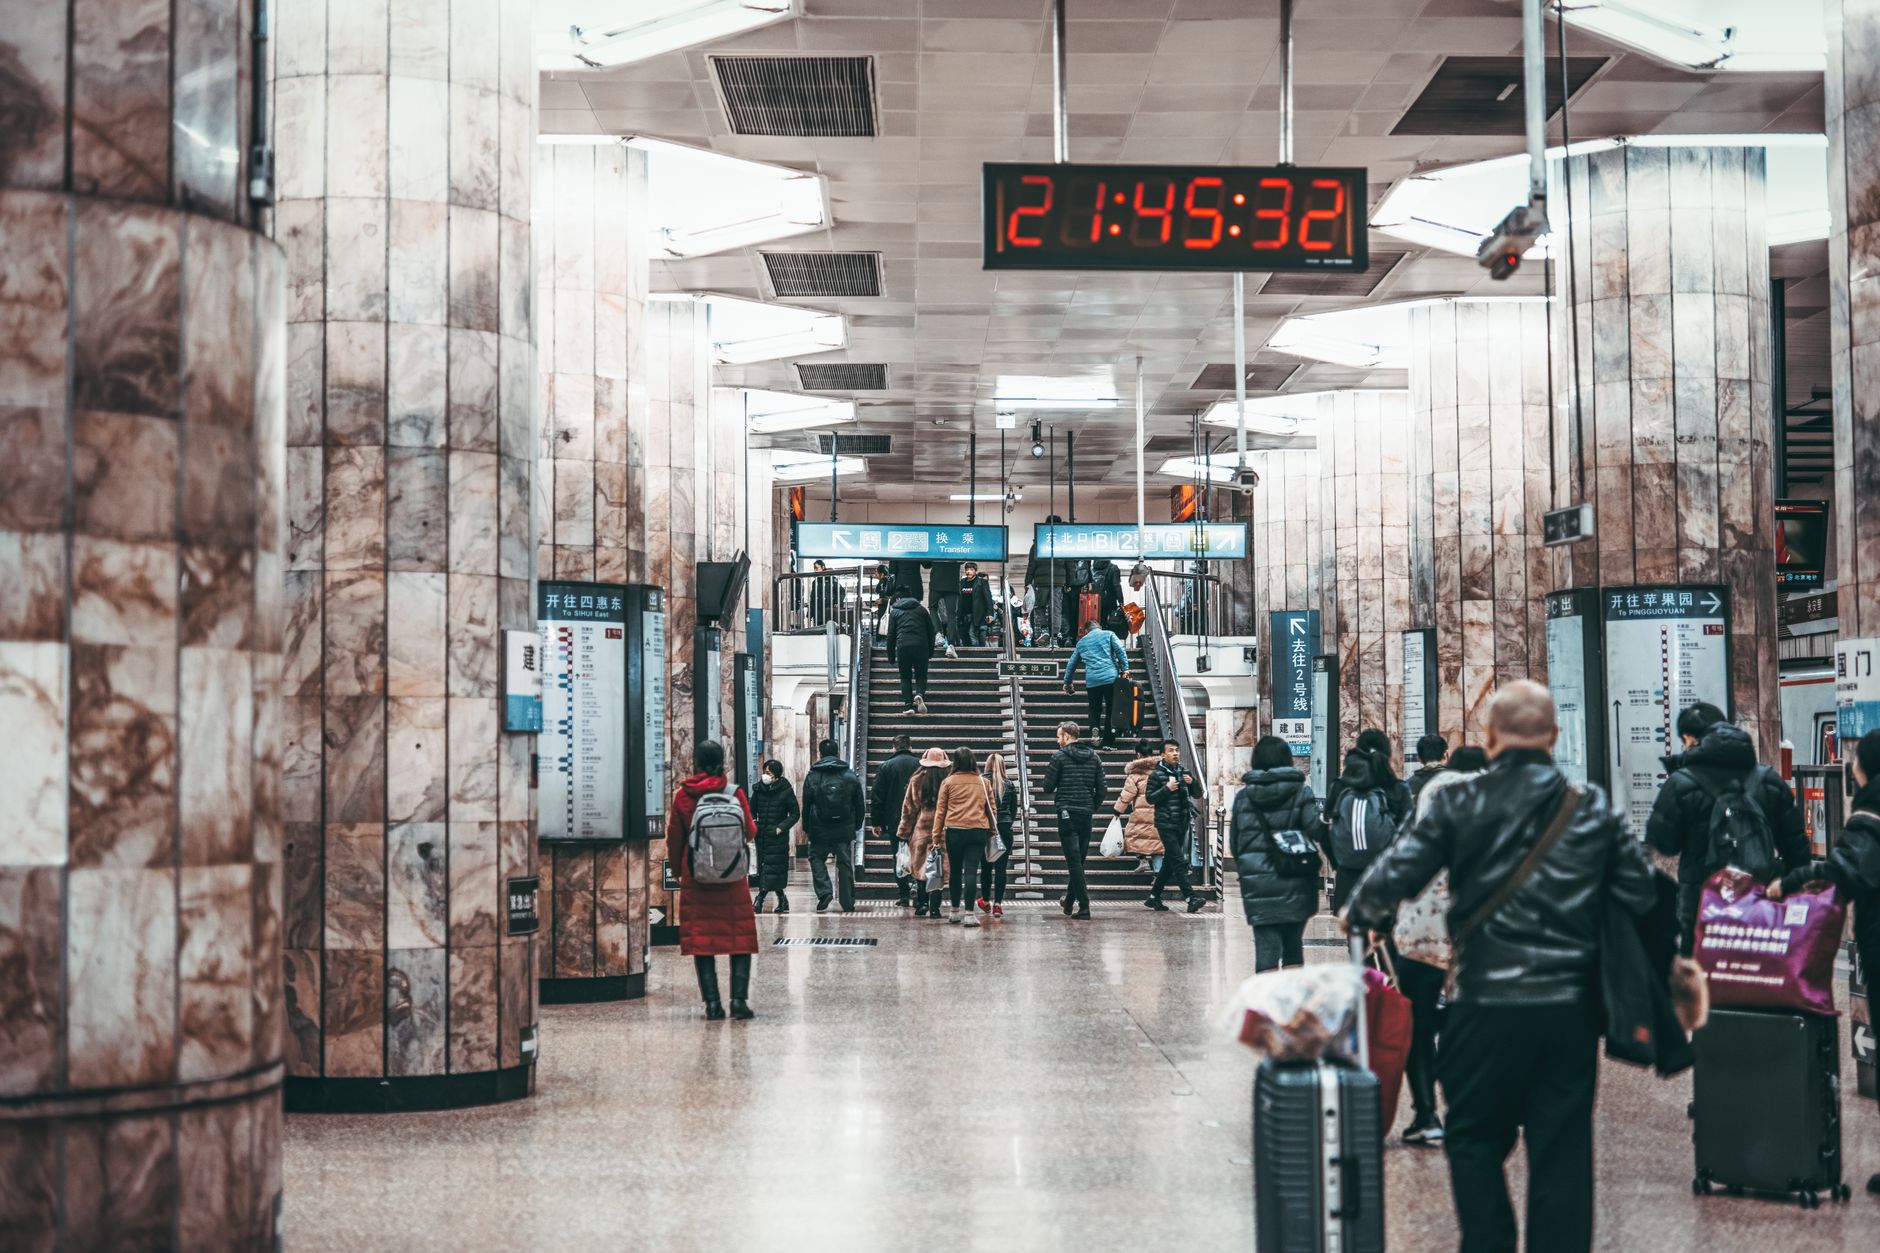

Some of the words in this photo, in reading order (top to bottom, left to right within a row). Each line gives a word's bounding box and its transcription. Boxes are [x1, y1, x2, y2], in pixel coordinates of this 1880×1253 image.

[1008, 176, 1344, 250] 21:45:32
[936, 532, 974, 544] 换乘
[1096, 533, 1108, 549] B
[940, 546, 971, 554] Transfer
[546, 594, 621, 610] 开往四惠东
[1611, 592, 1693, 608] 开往苹果园
[1629, 607, 1686, 616] PINGGUOYUAN
[1291, 638, 1308, 711] 去往2号线
[1280, 723, 1304, 733] 建国
